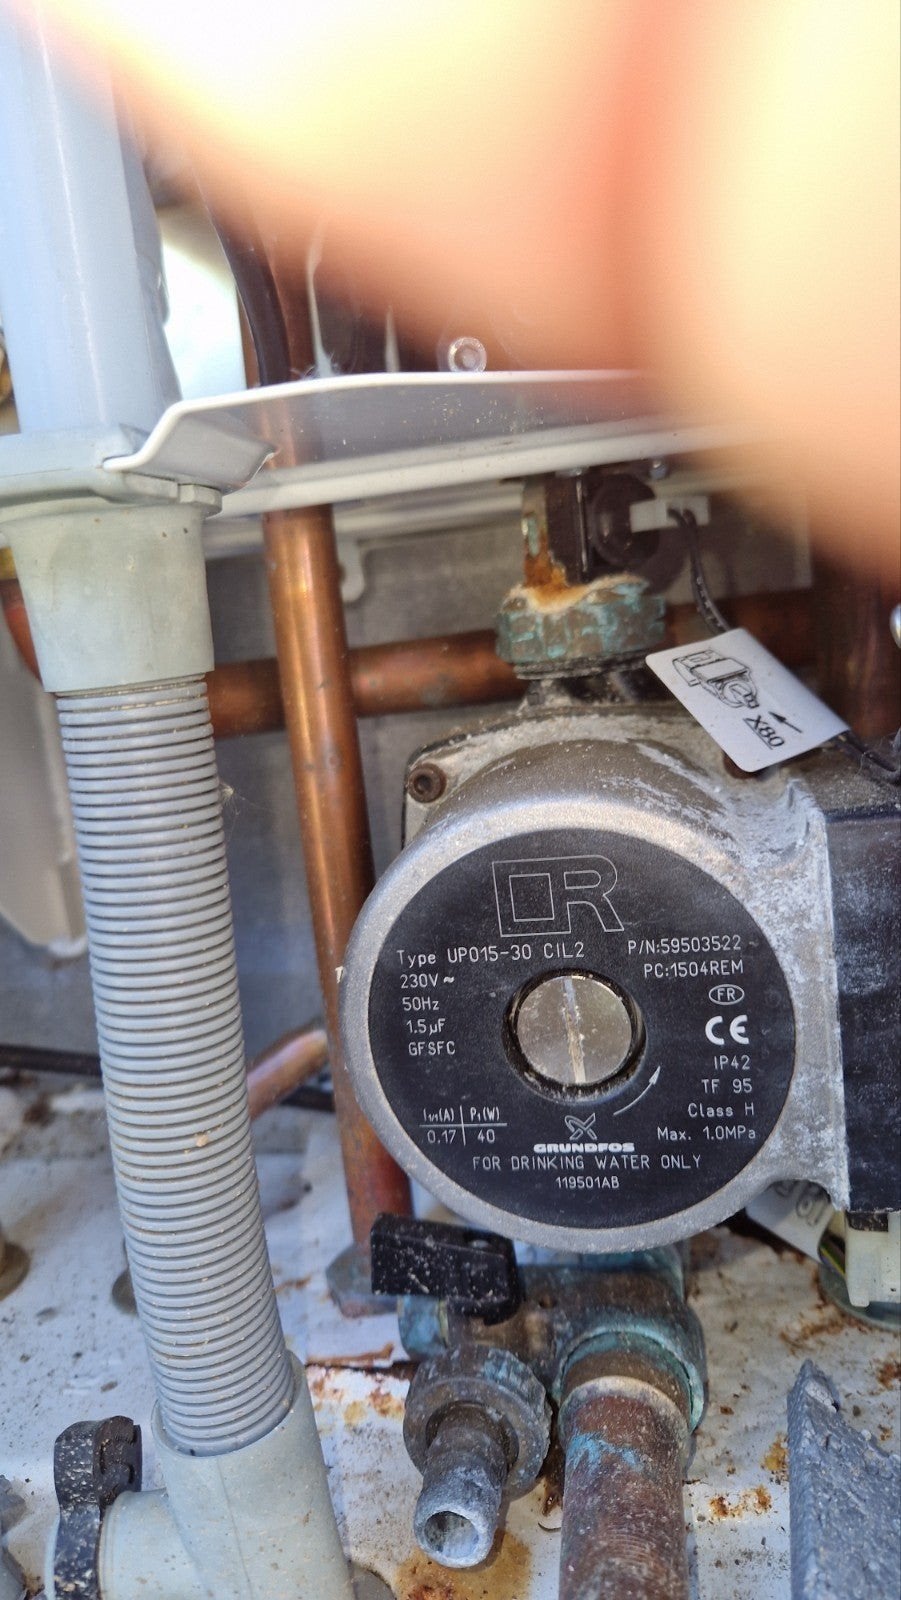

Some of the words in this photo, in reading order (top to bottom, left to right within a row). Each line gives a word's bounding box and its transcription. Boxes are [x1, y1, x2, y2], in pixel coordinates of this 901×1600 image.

[743, 714, 785, 750] X80
[628, 935, 741, 955] P/N:59503522
[397, 949, 436, 968] Type
[644, 960, 744, 978] PC:1504REM
[717, 988, 735, 1001] FR
[402, 997, 440, 1011] 50Hz
[705, 1015, 750, 1045] CE
[408, 1041, 456, 1056] GFSFC
[714, 1055, 751, 1071] IP42
[702, 1079, 720, 1094] TF
[733, 1078, 753, 1093] 95
[688, 1103, 734, 1118] Class
[745, 1102, 754, 1116] H
[427, 1129, 456, 1144] 0.17
[477, 1129, 495, 1143] 40
[657, 1127, 692, 1141] Max.
[703, 1126, 756, 1140] 1.0MPa
[533, 1142, 635, 1153] GRUNDFOS
[472, 1156, 501, 1171] FOR
[511, 1155, 584, 1170] DRINKING
[594, 1155, 650, 1170] WATER
[661, 1154, 702, 1169] ONLY
[556, 1176, 620, 1189] 119501AB
